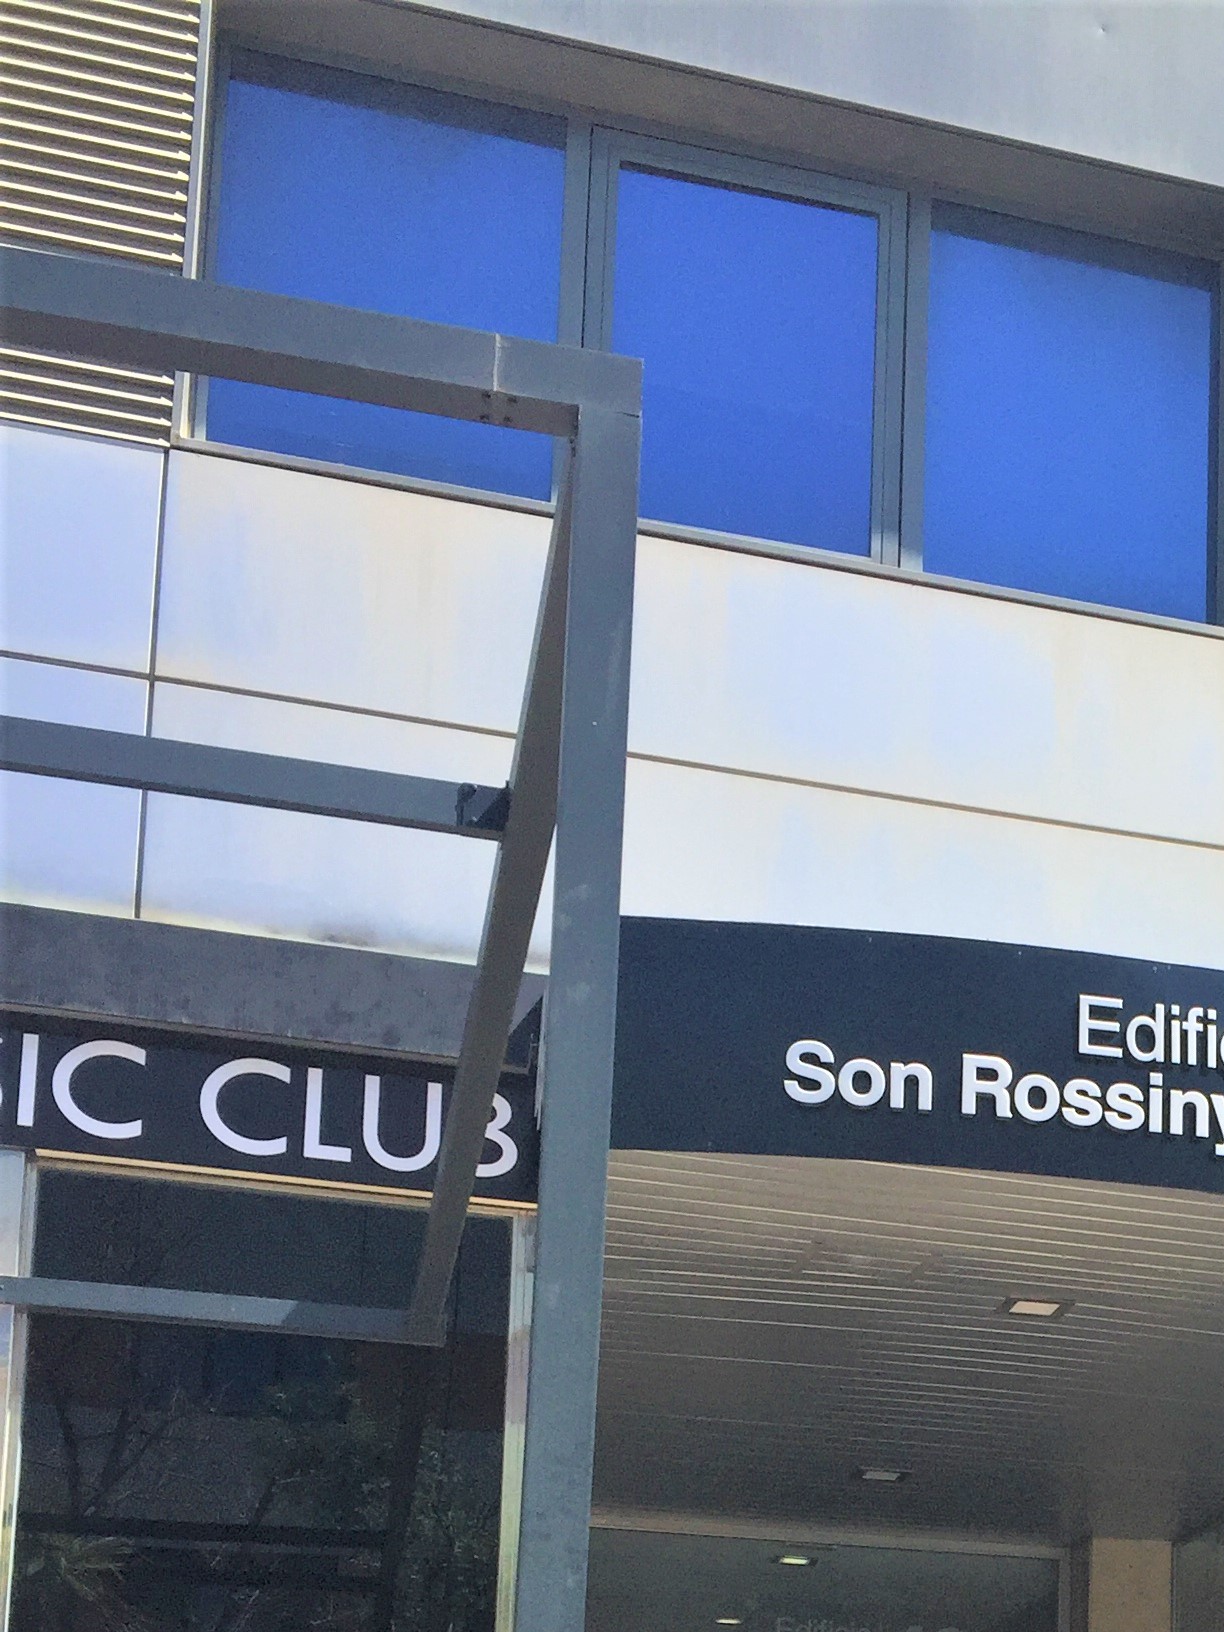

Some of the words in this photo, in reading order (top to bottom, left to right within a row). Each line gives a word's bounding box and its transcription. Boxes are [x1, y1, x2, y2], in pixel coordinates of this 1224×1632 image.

[0, 1033, 147, 1140] IC
[199, 1057, 519, 1178] CLUB
[782, 1037, 934, 1113] Son
